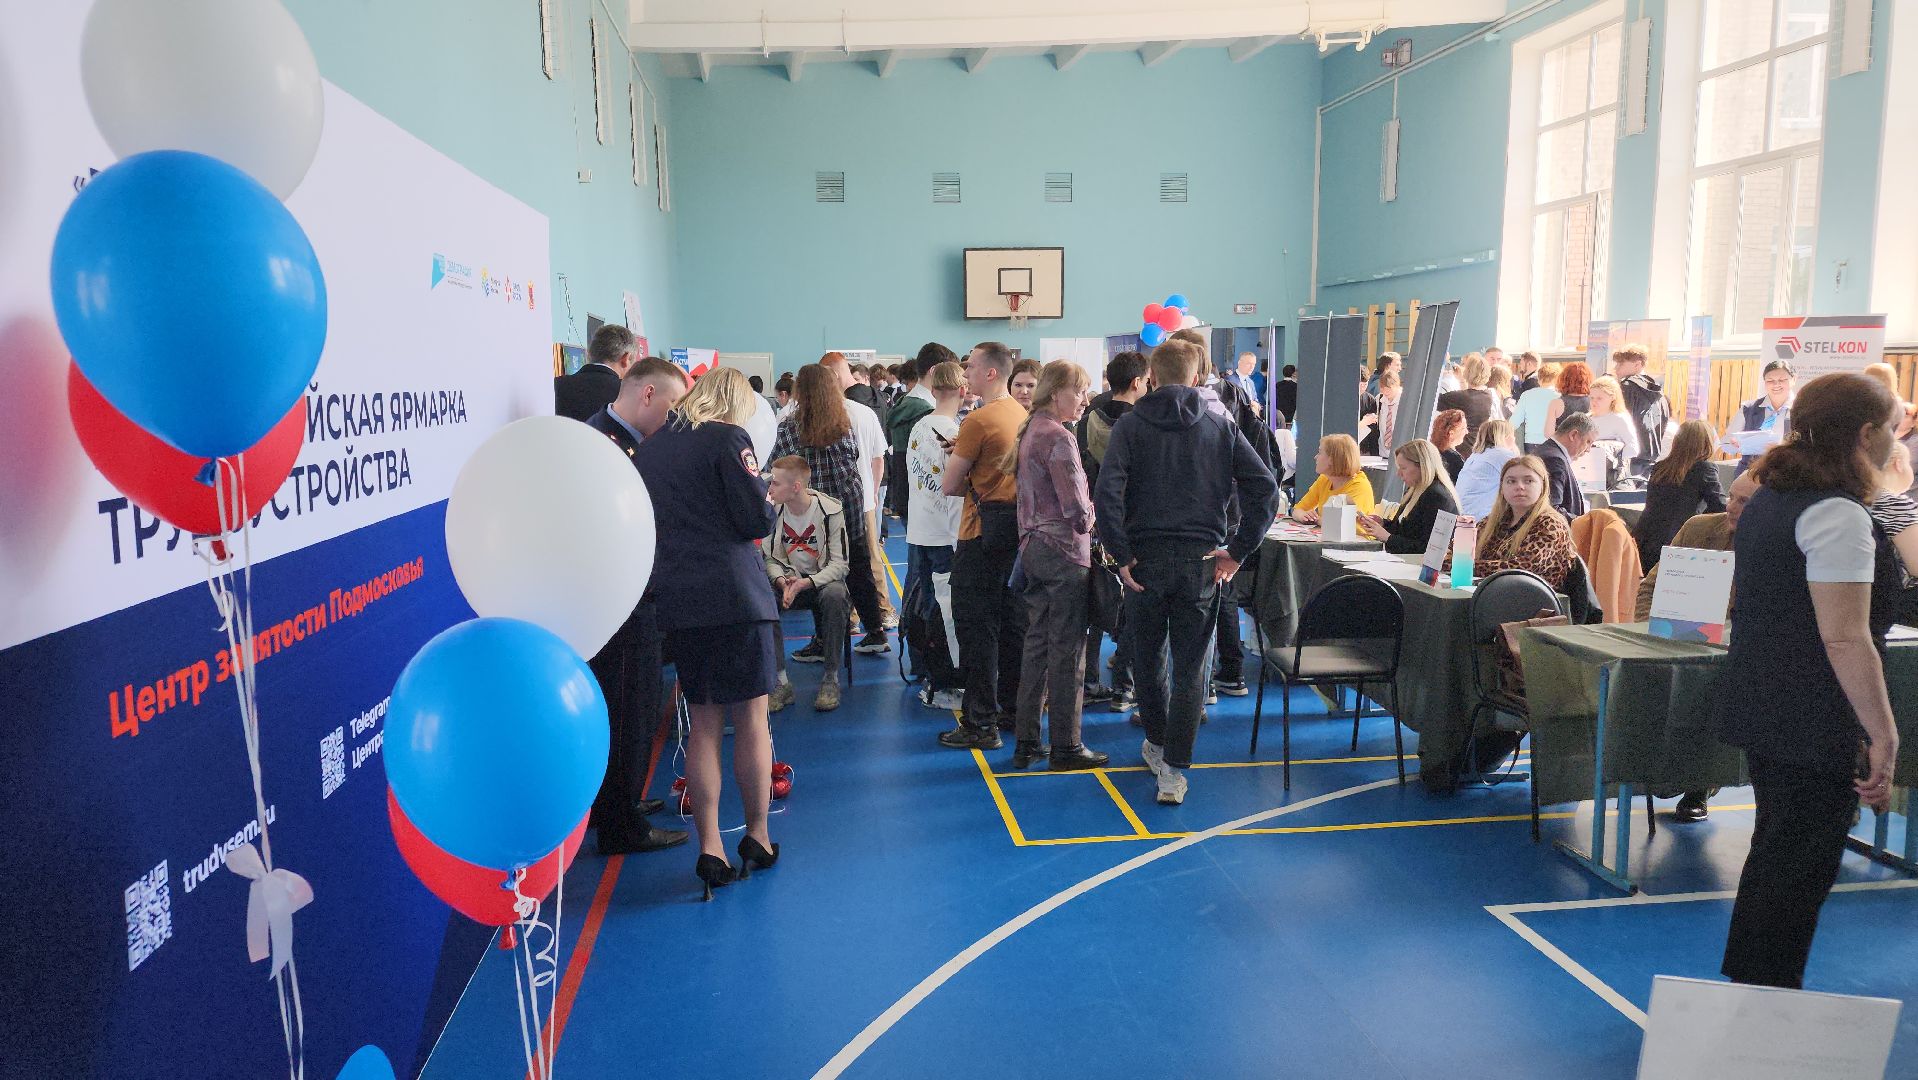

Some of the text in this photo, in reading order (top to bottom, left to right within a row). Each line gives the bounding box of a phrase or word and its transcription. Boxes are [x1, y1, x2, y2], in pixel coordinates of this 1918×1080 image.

[1803, 340, 1868, 354] STELKON
[306, 381, 468, 443] ЙСКАЯ ЯРМАРКА
[107, 659, 211, 739] Центр
[329, 555, 425, 624] Подмосковья
[182, 804, 276, 894] trudvsem.u
